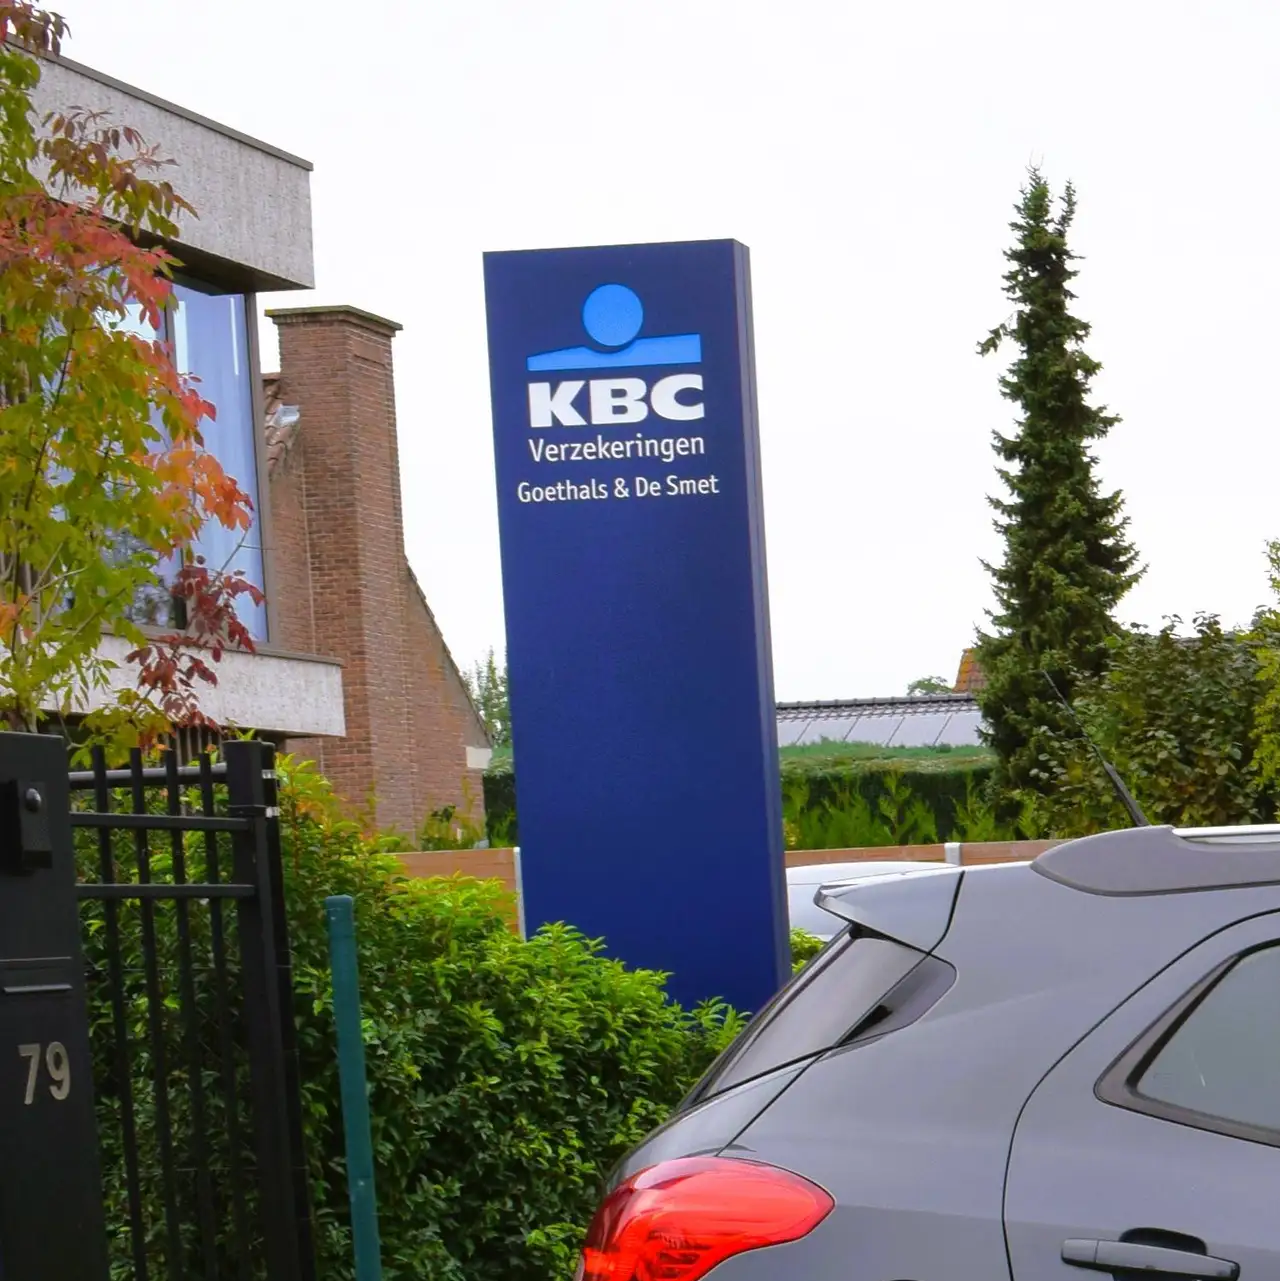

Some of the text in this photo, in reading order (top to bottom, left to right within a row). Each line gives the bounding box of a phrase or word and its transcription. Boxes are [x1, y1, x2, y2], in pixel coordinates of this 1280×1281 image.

[528, 373, 705, 428] KBC
[528, 433, 705, 463] Verzekeringen
[517, 474, 720, 503] Goethals & De Smet
[18, 1041, 71, 1105] 79
